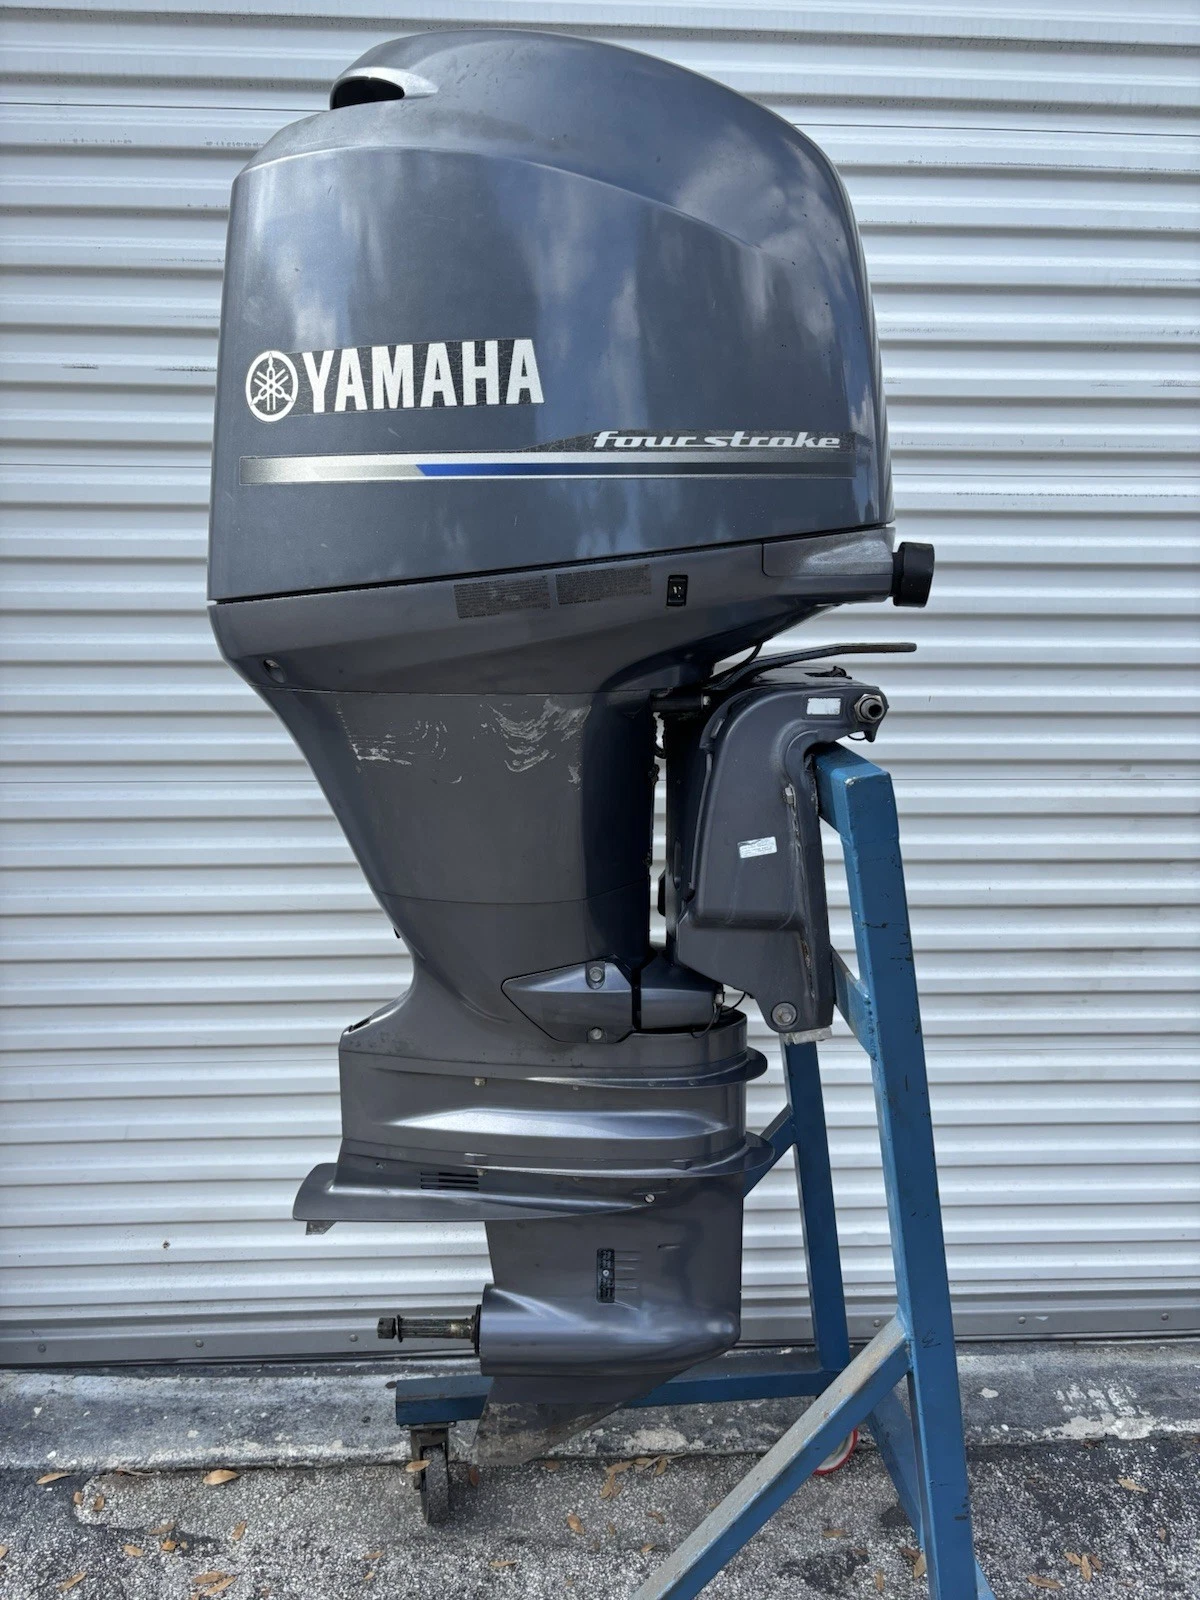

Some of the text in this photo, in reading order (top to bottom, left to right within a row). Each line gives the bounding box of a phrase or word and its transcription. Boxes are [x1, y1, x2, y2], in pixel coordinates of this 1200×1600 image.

[302, 339, 544, 413] YAMAHA
[593, 430, 841, 449] four stroke
